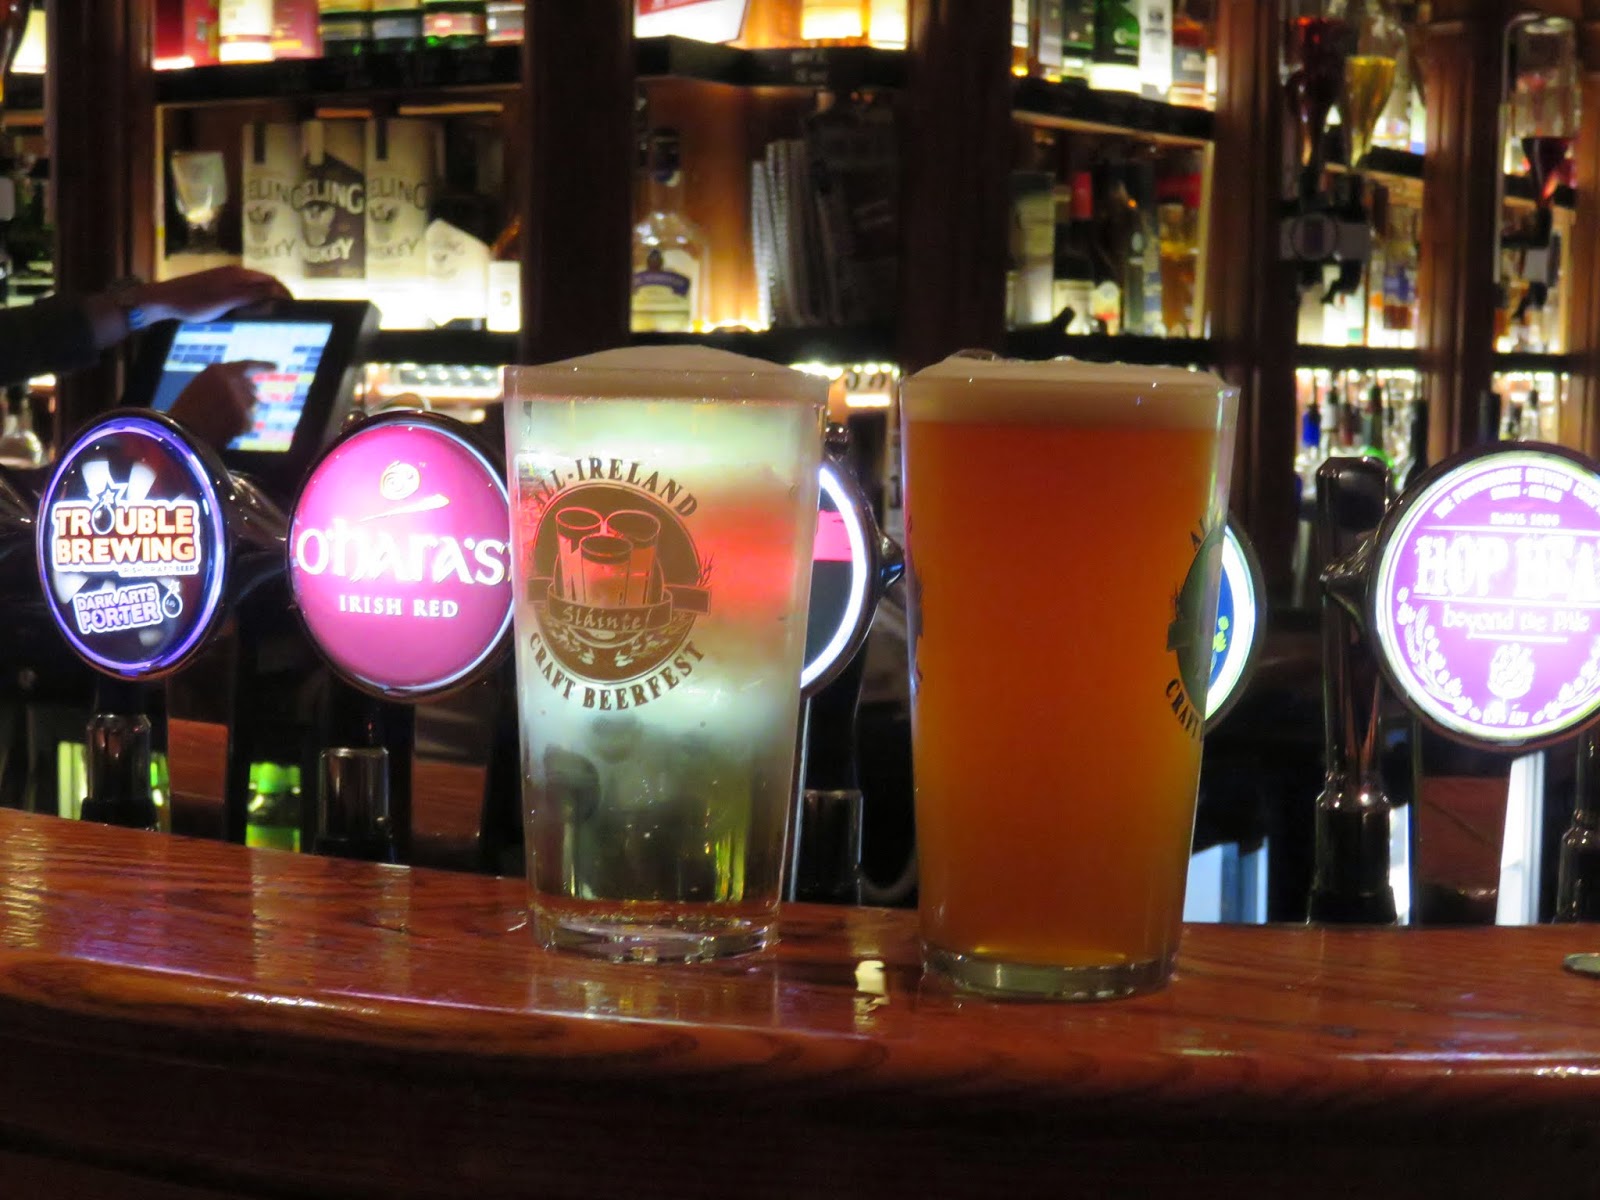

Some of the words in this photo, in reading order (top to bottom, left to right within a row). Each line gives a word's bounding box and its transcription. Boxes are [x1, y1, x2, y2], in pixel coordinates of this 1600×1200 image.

[55, 505, 194, 536] TROUBLE
[55, 537, 195, 565] BREWING
[78, 593, 115, 610] DARK
[119, 588, 155, 605] ARTS
[338, 594, 402, 616] IRISH
[413, 599, 459, 618] RED
[81, 602, 159, 629] PORTER
[529, 632, 576, 699] CRAFT
[583, 641, 706, 710] BEERFEST
